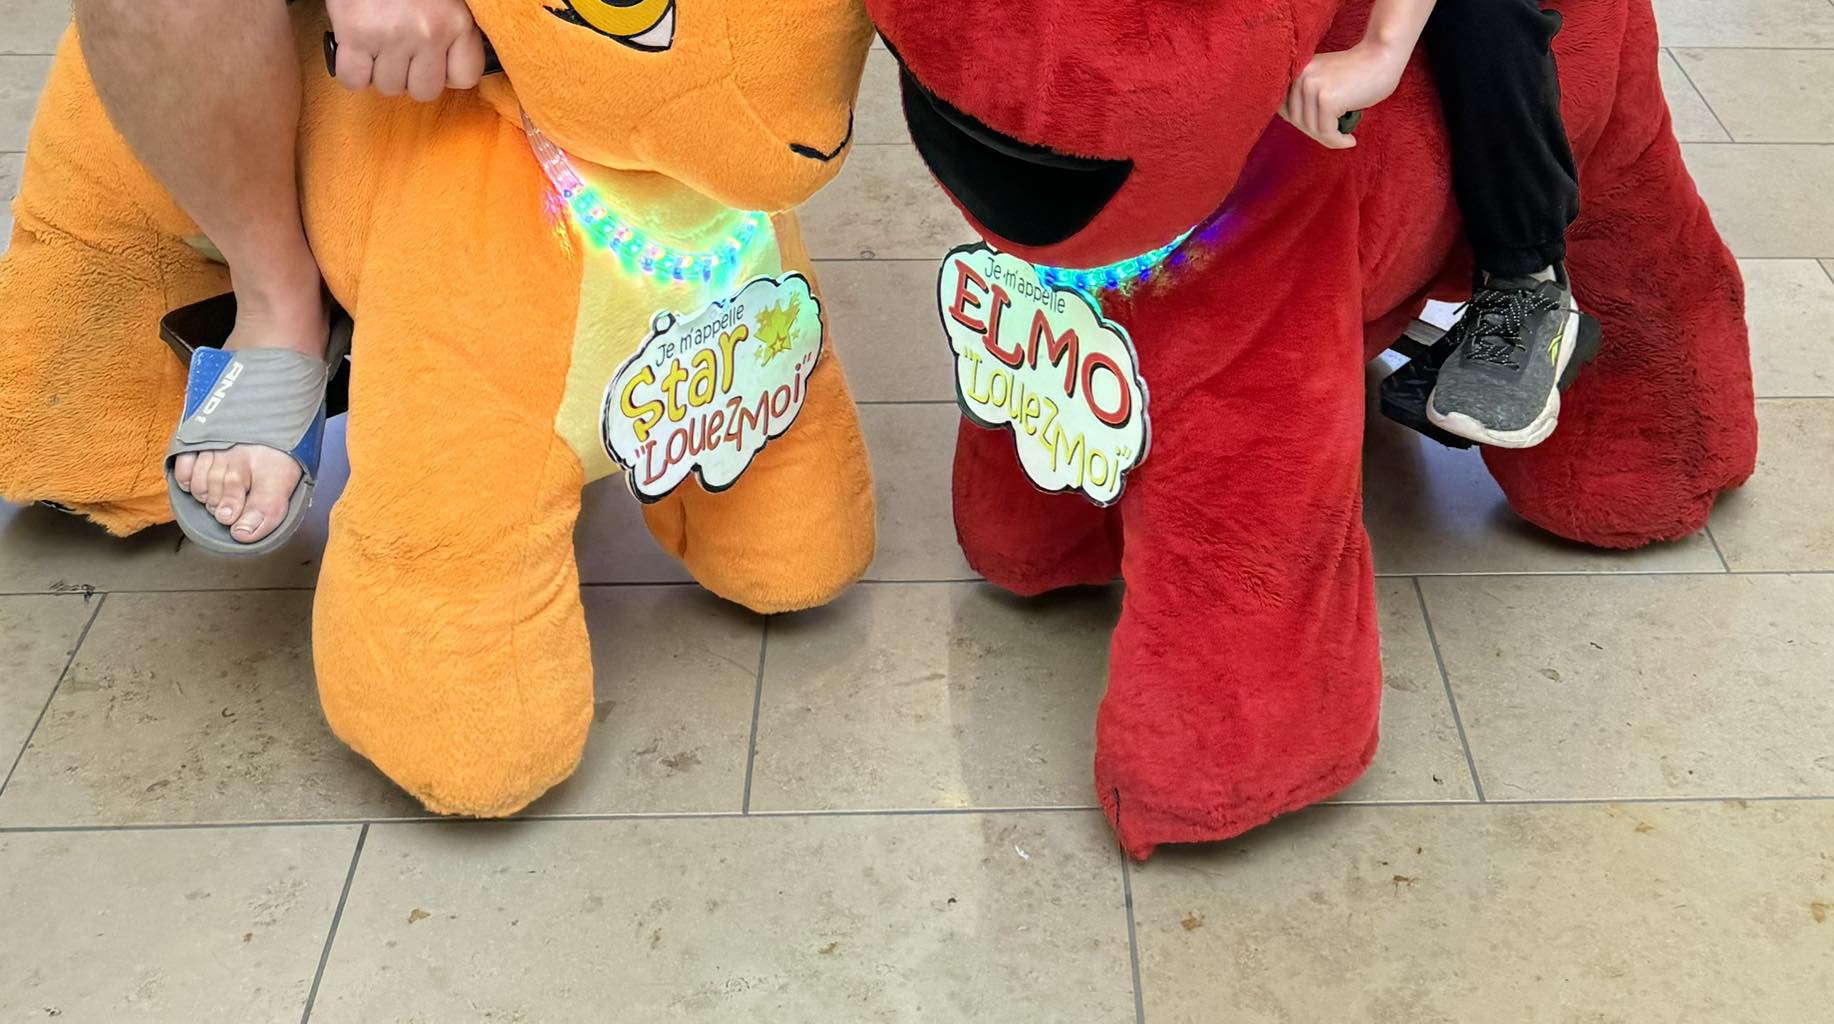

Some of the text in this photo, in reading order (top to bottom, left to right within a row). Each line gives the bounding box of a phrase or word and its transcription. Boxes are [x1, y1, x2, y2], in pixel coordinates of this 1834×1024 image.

[984, 256, 1066, 314] Je m'appelle
[655, 303, 745, 368] Je m'appelle
[948, 259, 1132, 429] ELMO
[620, 324, 749, 442] Star
